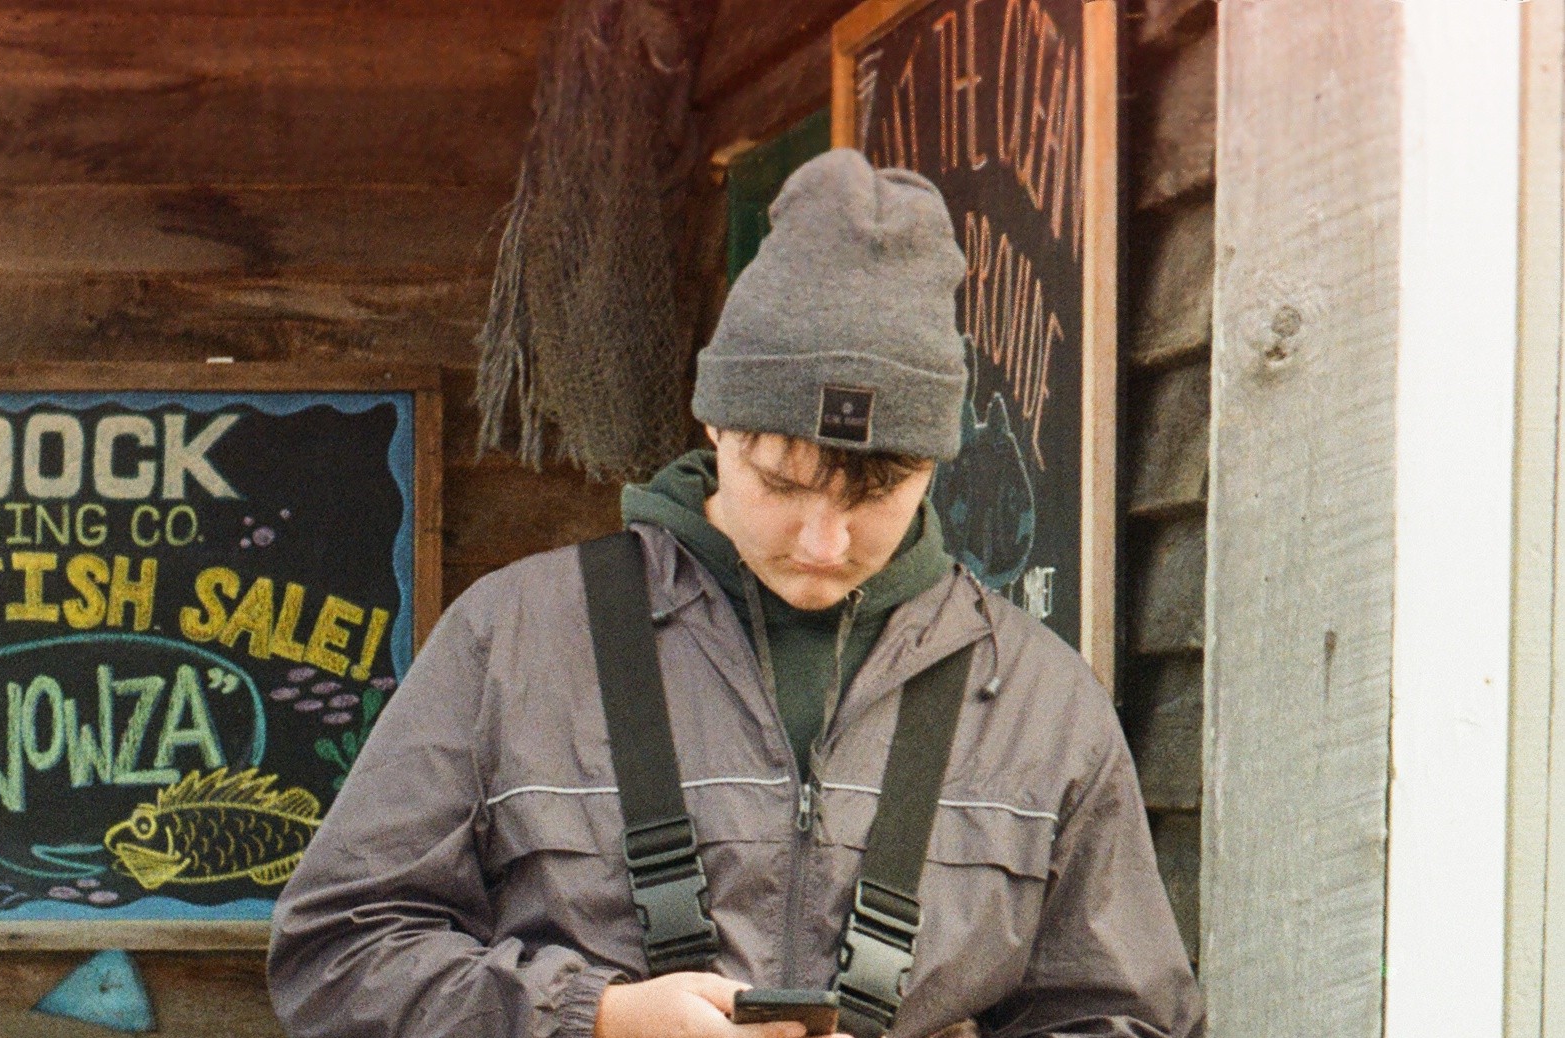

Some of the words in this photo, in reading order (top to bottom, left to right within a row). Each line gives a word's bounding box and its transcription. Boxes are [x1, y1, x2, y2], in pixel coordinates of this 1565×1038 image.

[932, 0, 988, 175] THE
[130, 503, 205, 547] CO.
[179, 566, 390, 682] SALE!
